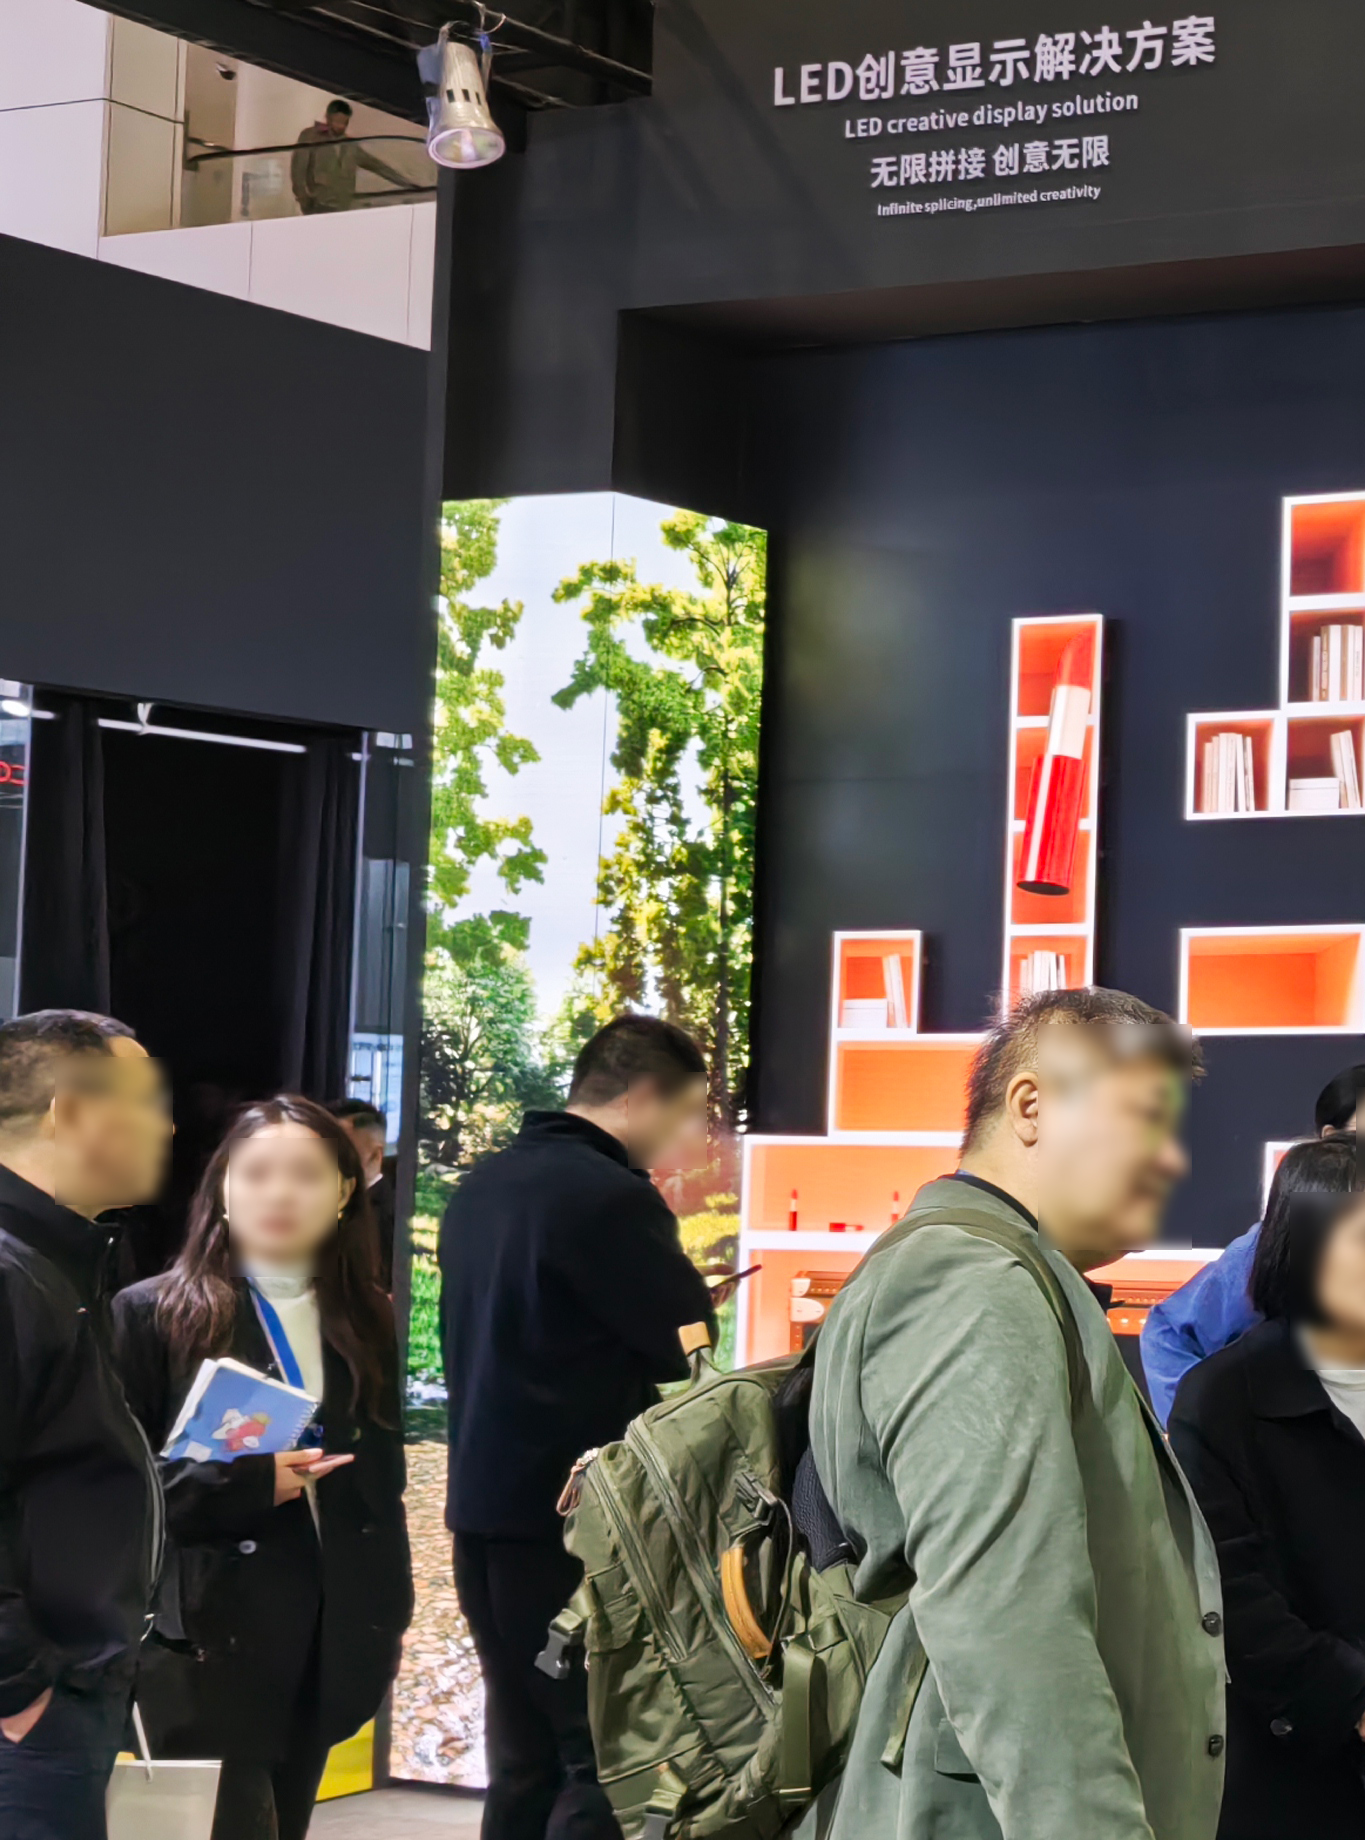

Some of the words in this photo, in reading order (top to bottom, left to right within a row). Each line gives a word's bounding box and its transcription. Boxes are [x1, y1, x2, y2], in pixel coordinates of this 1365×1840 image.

[774, 14, 1216, 106] LED创意显示解决方案
[844, 117, 883, 139] LED
[887, 109, 970, 134] creative
[972, 100, 1048, 128] display
[1051, 91, 1139, 118] solution
[870, 147, 986, 188] 无限拼接
[991, 134, 1110, 177] 创意无限
[1039, 184, 1101, 202] creativity
